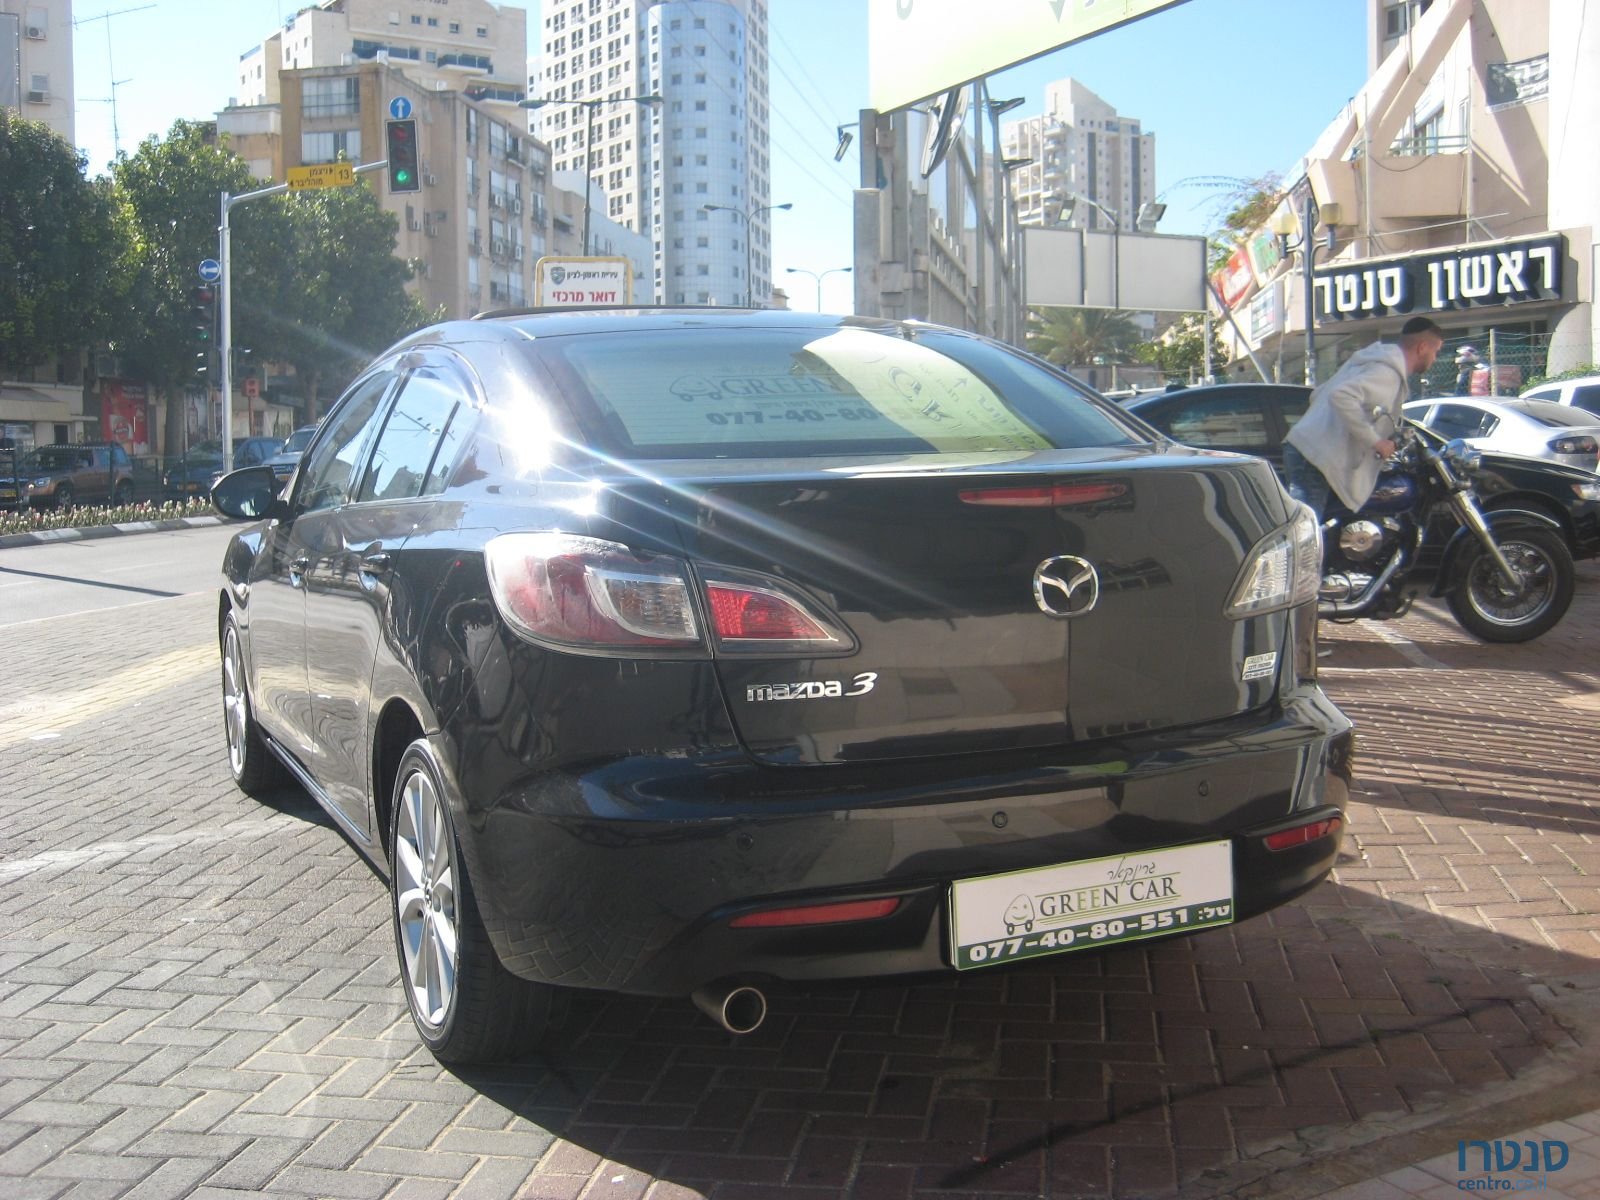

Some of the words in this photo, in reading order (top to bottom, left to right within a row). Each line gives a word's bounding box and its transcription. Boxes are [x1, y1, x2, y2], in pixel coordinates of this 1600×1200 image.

[339, 169, 350, 180] 13
[1313, 267, 1402, 314] סנטר
[1427, 246, 1555, 310] ראשון
[552, 291, 584, 302] מרכזי
[588, 291, 616, 302] דואר
[844, 671, 878, 697] 3
[1039, 884, 1119, 917] GREEN
[1130, 877, 1177, 902] CAR
[1198, 904, 1230, 921] טל:
[969, 909, 1188, 962] 077-40-80-551
